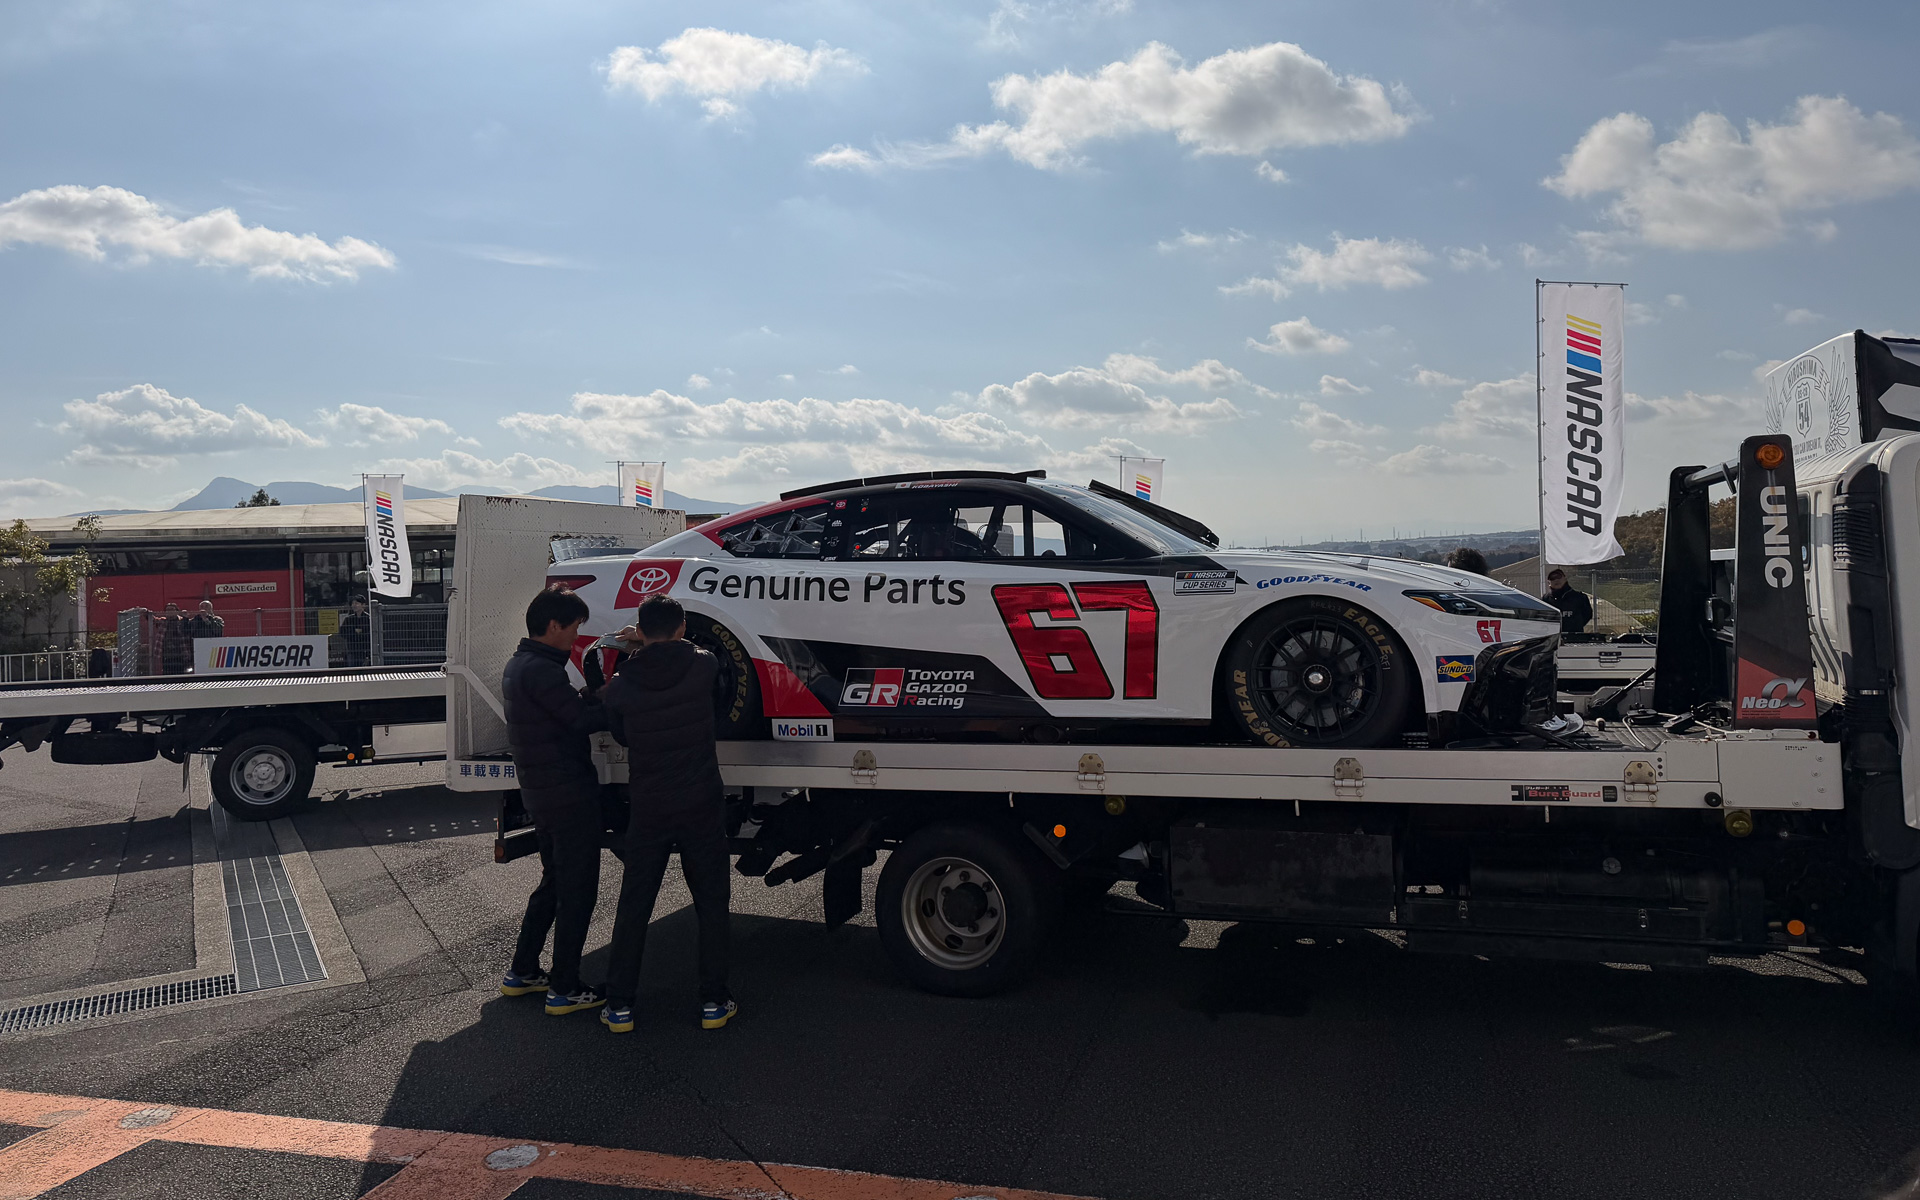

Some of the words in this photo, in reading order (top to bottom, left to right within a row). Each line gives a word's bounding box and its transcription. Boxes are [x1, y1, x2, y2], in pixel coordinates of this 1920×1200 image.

[1788, 360, 1817, 389] HIROSHIMA
[1799, 401, 1809, 430] 54
[1567, 367, 1602, 537] NASCAR
[1760, 486, 1793, 589] UNIC
[377, 513, 401, 586] NASCAR
[688, 566, 850, 602] Genuine
[863, 572, 966, 605] Parts
[1182, 581, 1198, 589] CUP
[1199, 580, 1227, 588] SERIES
[1256, 574, 1372, 592] GOODYEAR
[990, 579, 1160, 700] 67
[1343, 608, 1393, 654] EAGLE
[1476, 620, 1502, 643] 67
[233, 645, 313, 668] NASCAR
[711, 624, 748, 721] GOODYEAR
[908, 669, 975, 681] TOYOTA
[1438, 665, 1473, 674] SUNOCO
[843, 683, 899, 704] GR
[905, 682, 968, 693] GAZOO
[903, 694, 965, 709] Racing
[1741, 696, 1781, 709] Neo
[778, 724, 813, 736] Mobil
[460, 764, 515, 778] 車載専用
[1529, 789, 1560, 797] Bure
[1561, 790, 1601, 798] Guard
